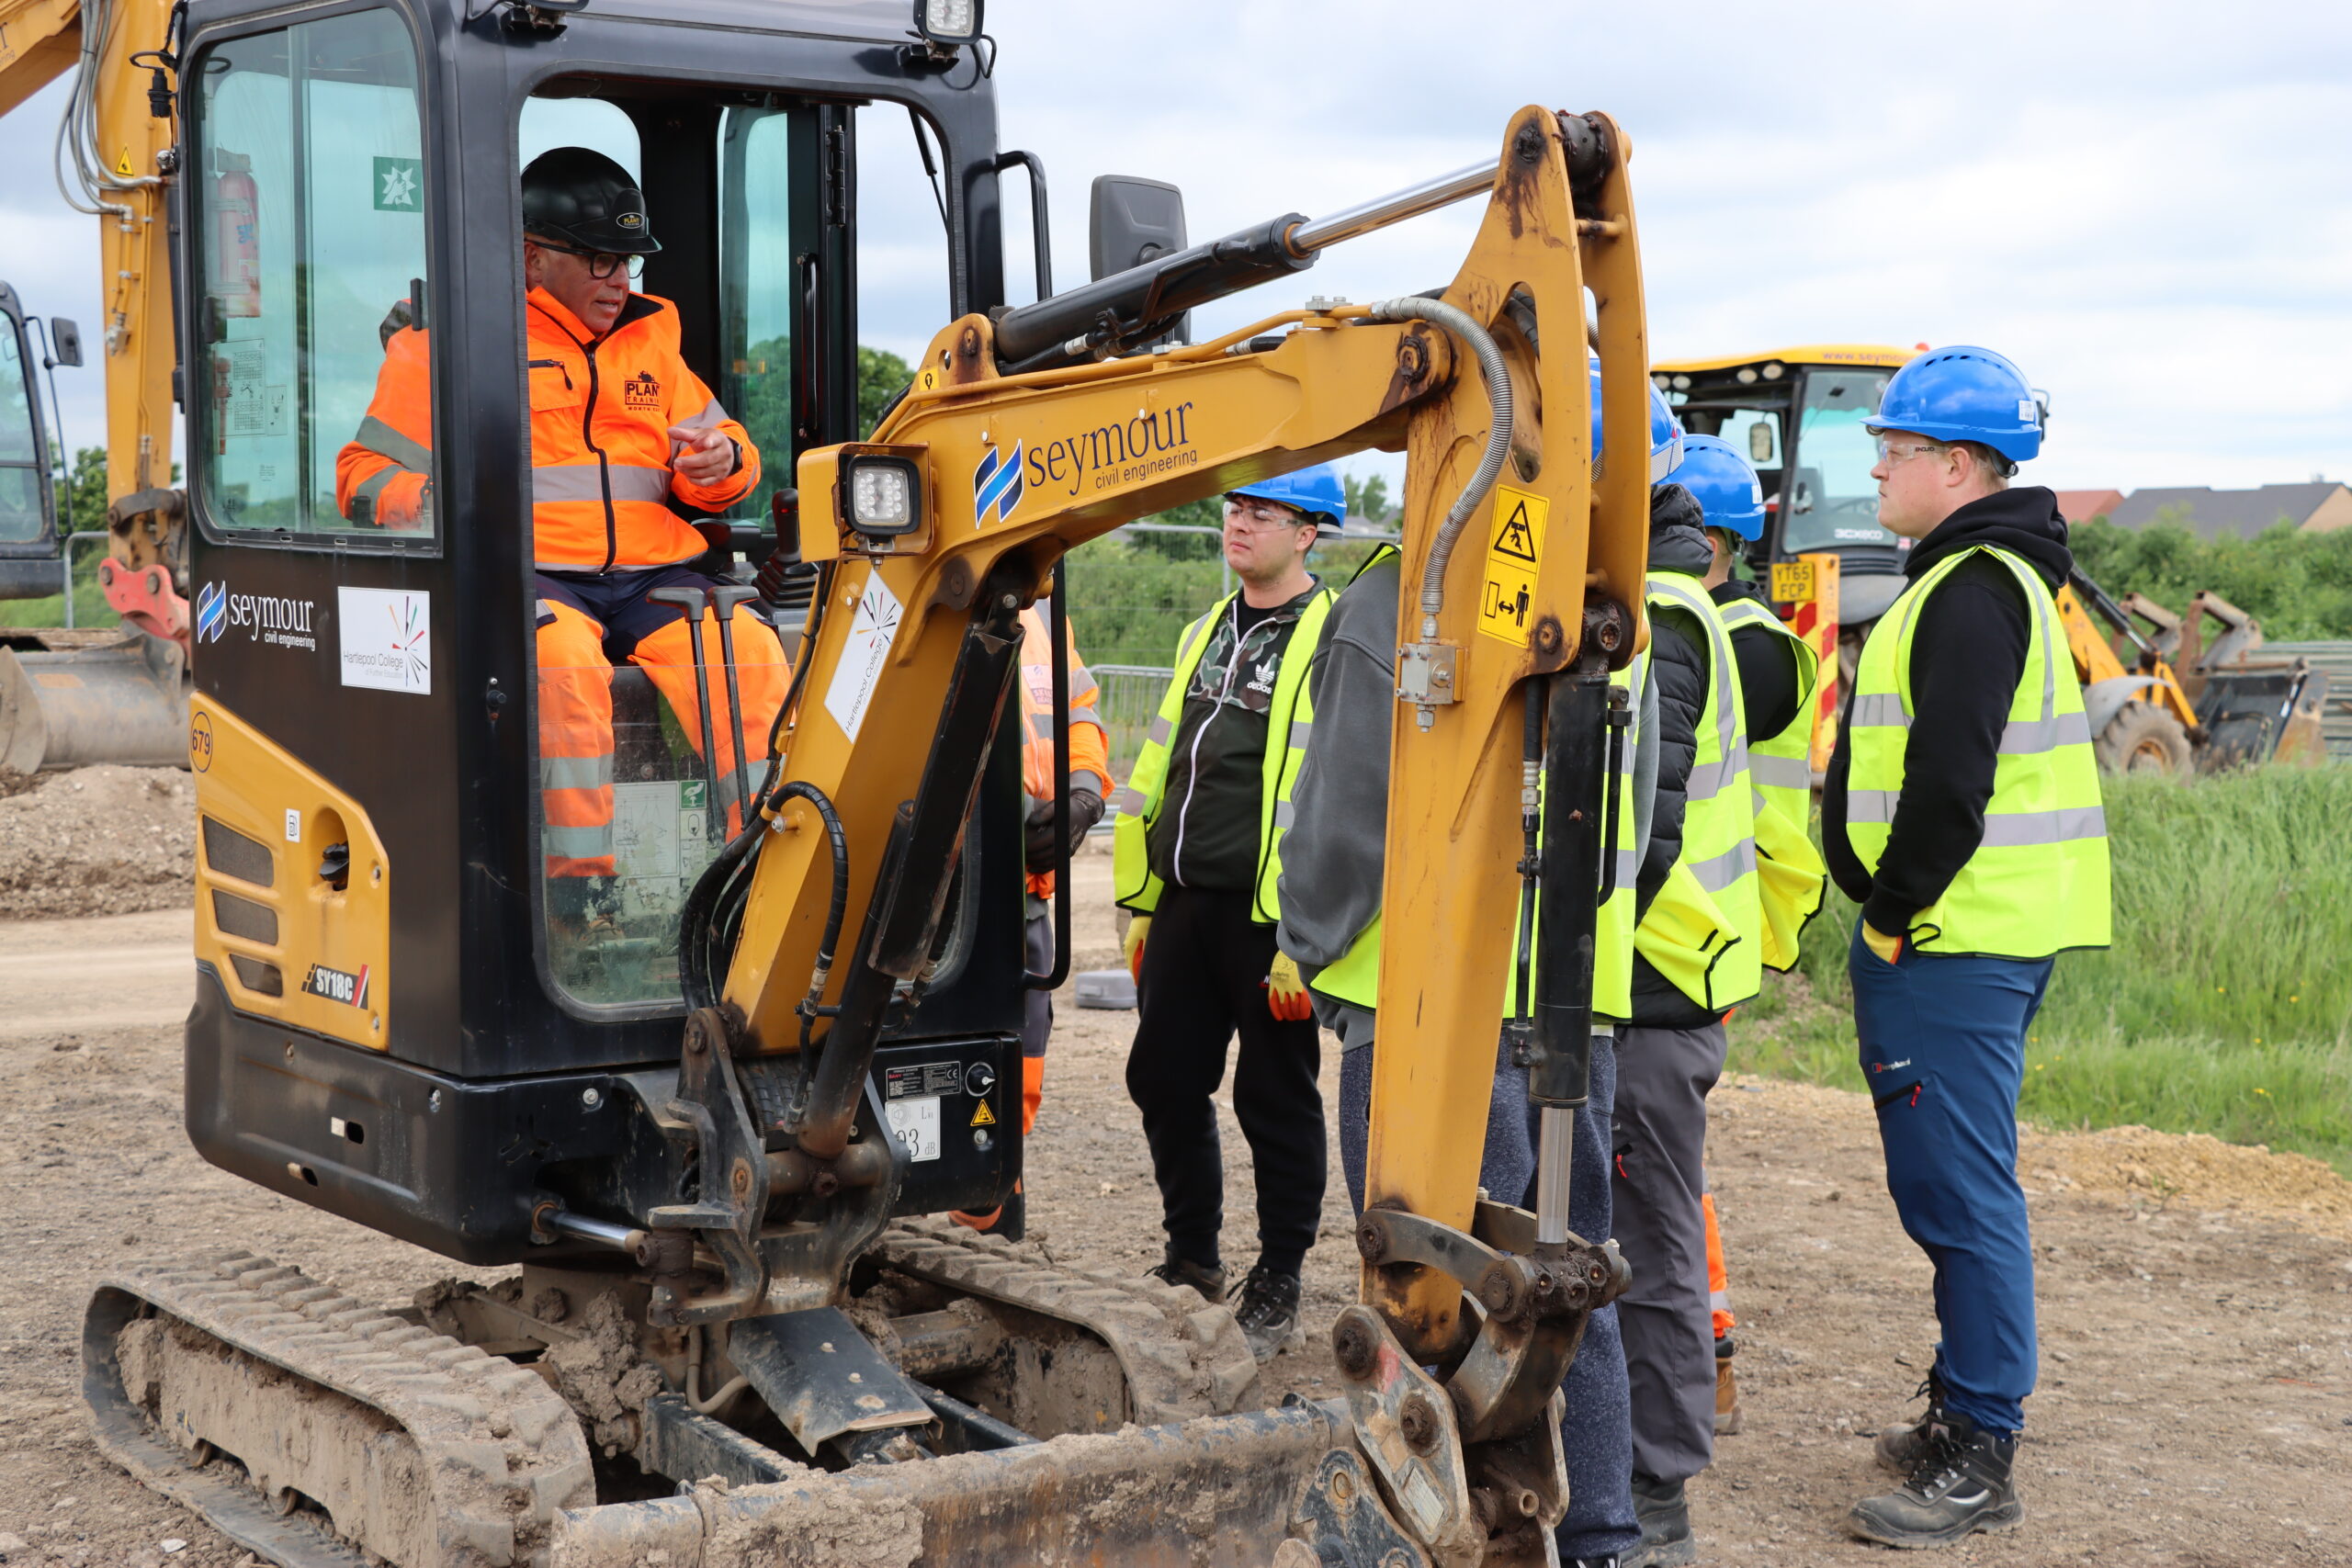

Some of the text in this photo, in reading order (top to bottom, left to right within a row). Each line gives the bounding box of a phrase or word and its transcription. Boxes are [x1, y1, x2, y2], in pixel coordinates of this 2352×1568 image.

[1028, 400, 1193, 497] seymour
[1095, 448, 1198, 490] civil engineering
[1775, 564, 1810, 581] YT65
[1780, 582, 1806, 598] FCP
[230, 593, 314, 642] seymour
[264, 629, 316, 652] civil engineering
[343, 649, 404, 671] Hartlepool College
[845, 678, 868, 733] Hartlepool
[865, 637, 883, 679] College
[192, 728, 210, 755] 679
[315, 967, 354, 1001] SY18C
[924, 1142, 936, 1156] dB
